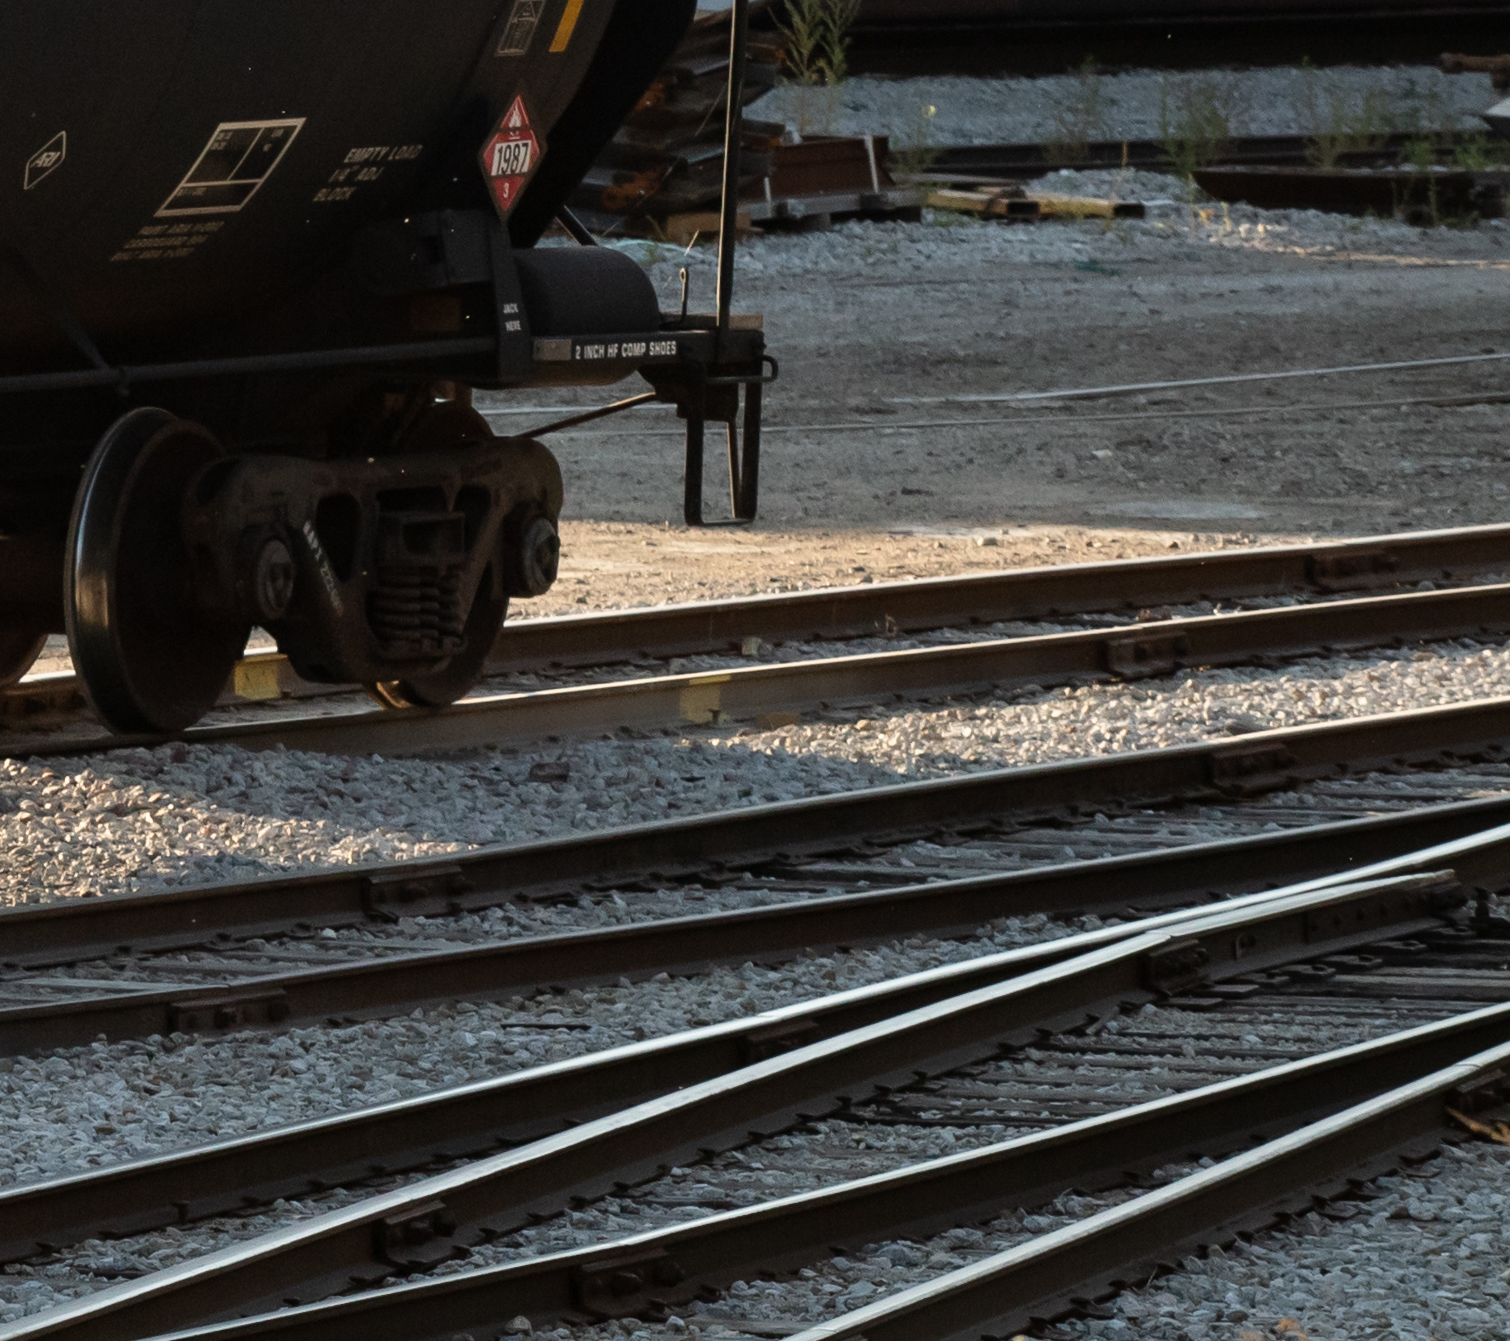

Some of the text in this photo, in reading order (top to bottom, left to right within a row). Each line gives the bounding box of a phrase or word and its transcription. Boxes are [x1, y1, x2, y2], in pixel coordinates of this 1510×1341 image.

[344, 146, 390, 163] EMPTY
[497, 142, 528, 175] 1987
[503, 182, 509, 198] 3
[576, 341, 677, 359] 2 INCH HF COMP SHOES
